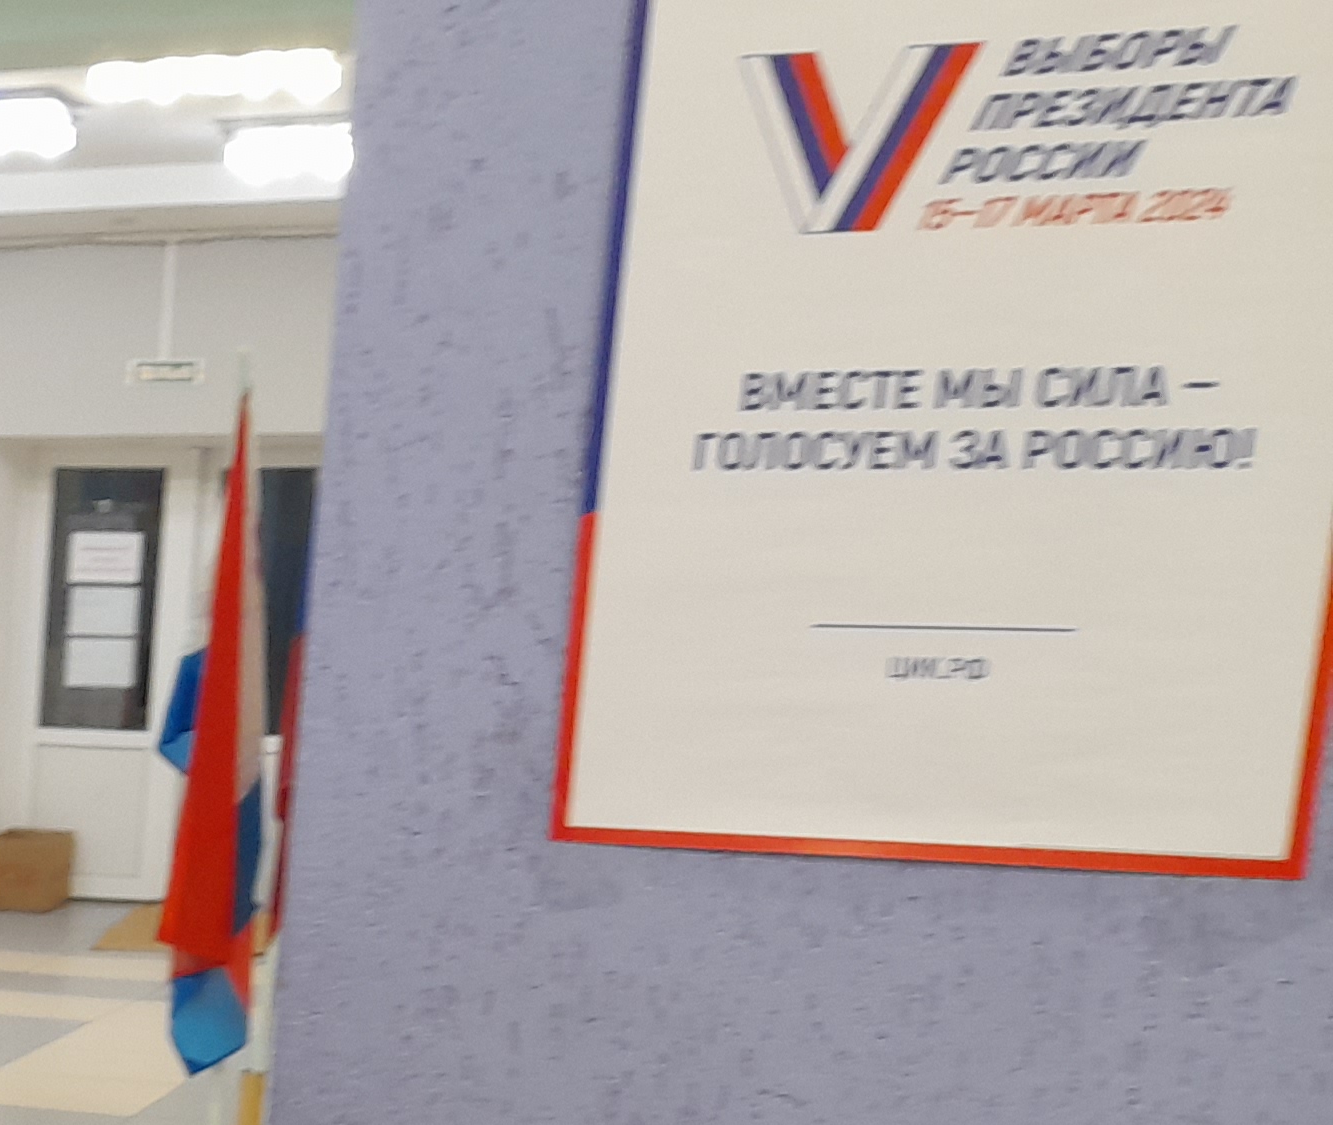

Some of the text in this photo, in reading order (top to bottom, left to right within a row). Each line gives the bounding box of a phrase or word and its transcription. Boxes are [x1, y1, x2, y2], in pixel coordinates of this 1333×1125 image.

[999, 25, 1239, 76] ВЫБОРЫ
[969, 75, 1298, 130] ПРЕЗИДЕНТА
[938, 139, 1147, 184] РОССИИ
[1010, 190, 1139, 227] МАРТА
[1133, 186, 1233, 223] 2024
[739, 369, 924, 411] ВМЕСТЕ
[934, 368, 1025, 409] МЫ
[1035, 365, 1169, 408] СИЛА
[691, 427, 1258, 470] ГОЛОСУЕМ ЗА РОССИЮ!
